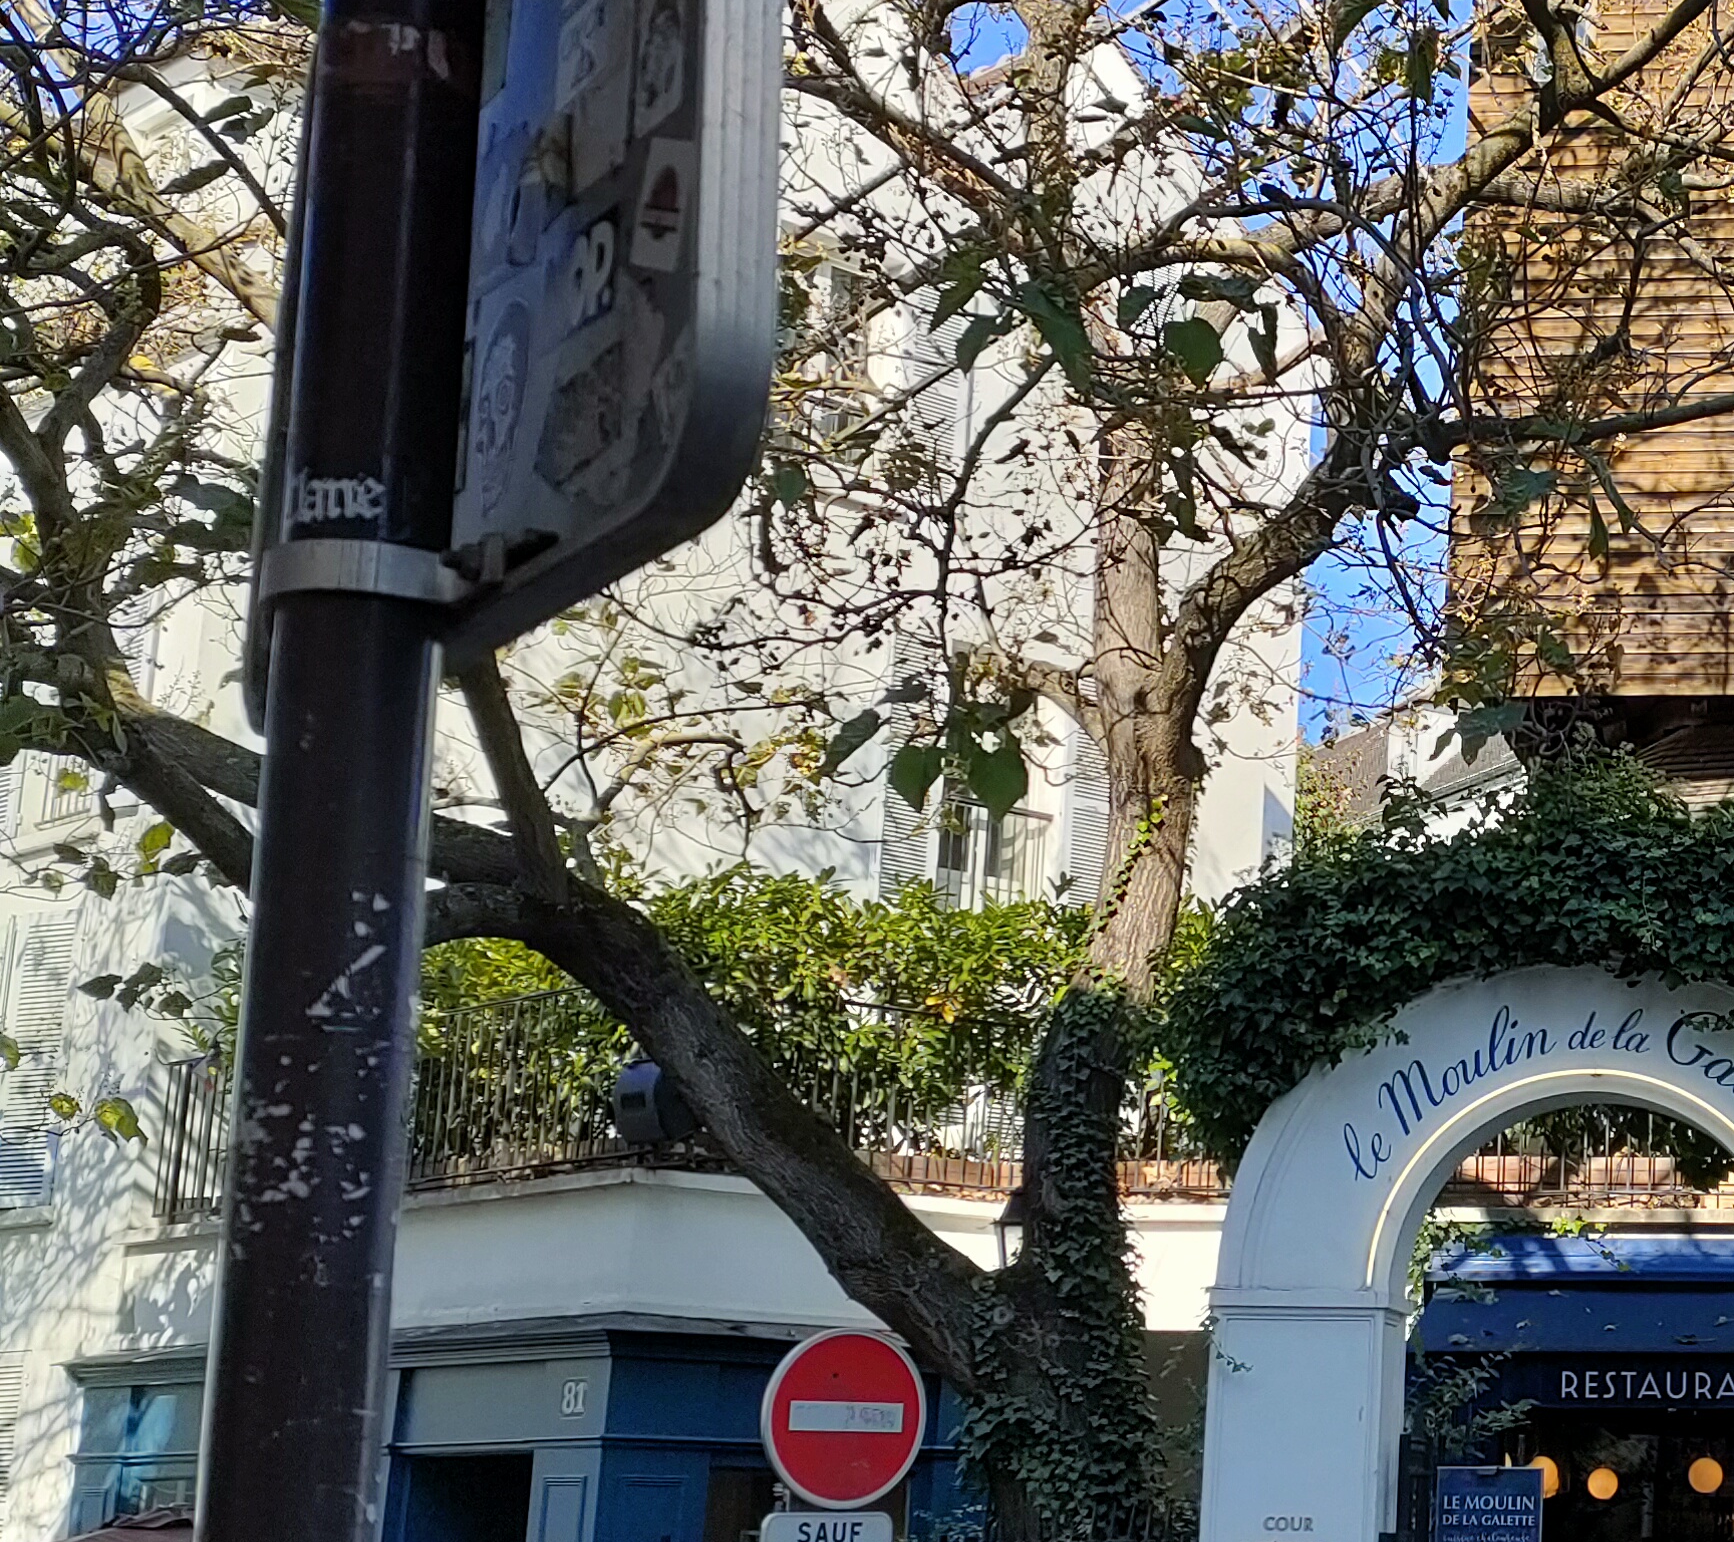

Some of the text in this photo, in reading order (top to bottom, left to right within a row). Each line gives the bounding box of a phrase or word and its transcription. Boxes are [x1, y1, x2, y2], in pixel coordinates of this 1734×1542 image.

[1342, 1121, 1392, 1182] le
[1378, 1004, 1558, 1137] Moulin
[1568, 1011, 1605, 1051] de
[1610, 1007, 1650, 1054] la
[561, 1381, 588, 1415] 81
[1442, 1495, 1535, 1511] LE MOULIN
[1263, 1515, 1314, 1532] COUR
[1441, 1514, 1536, 1527] DE LA GALETTE
